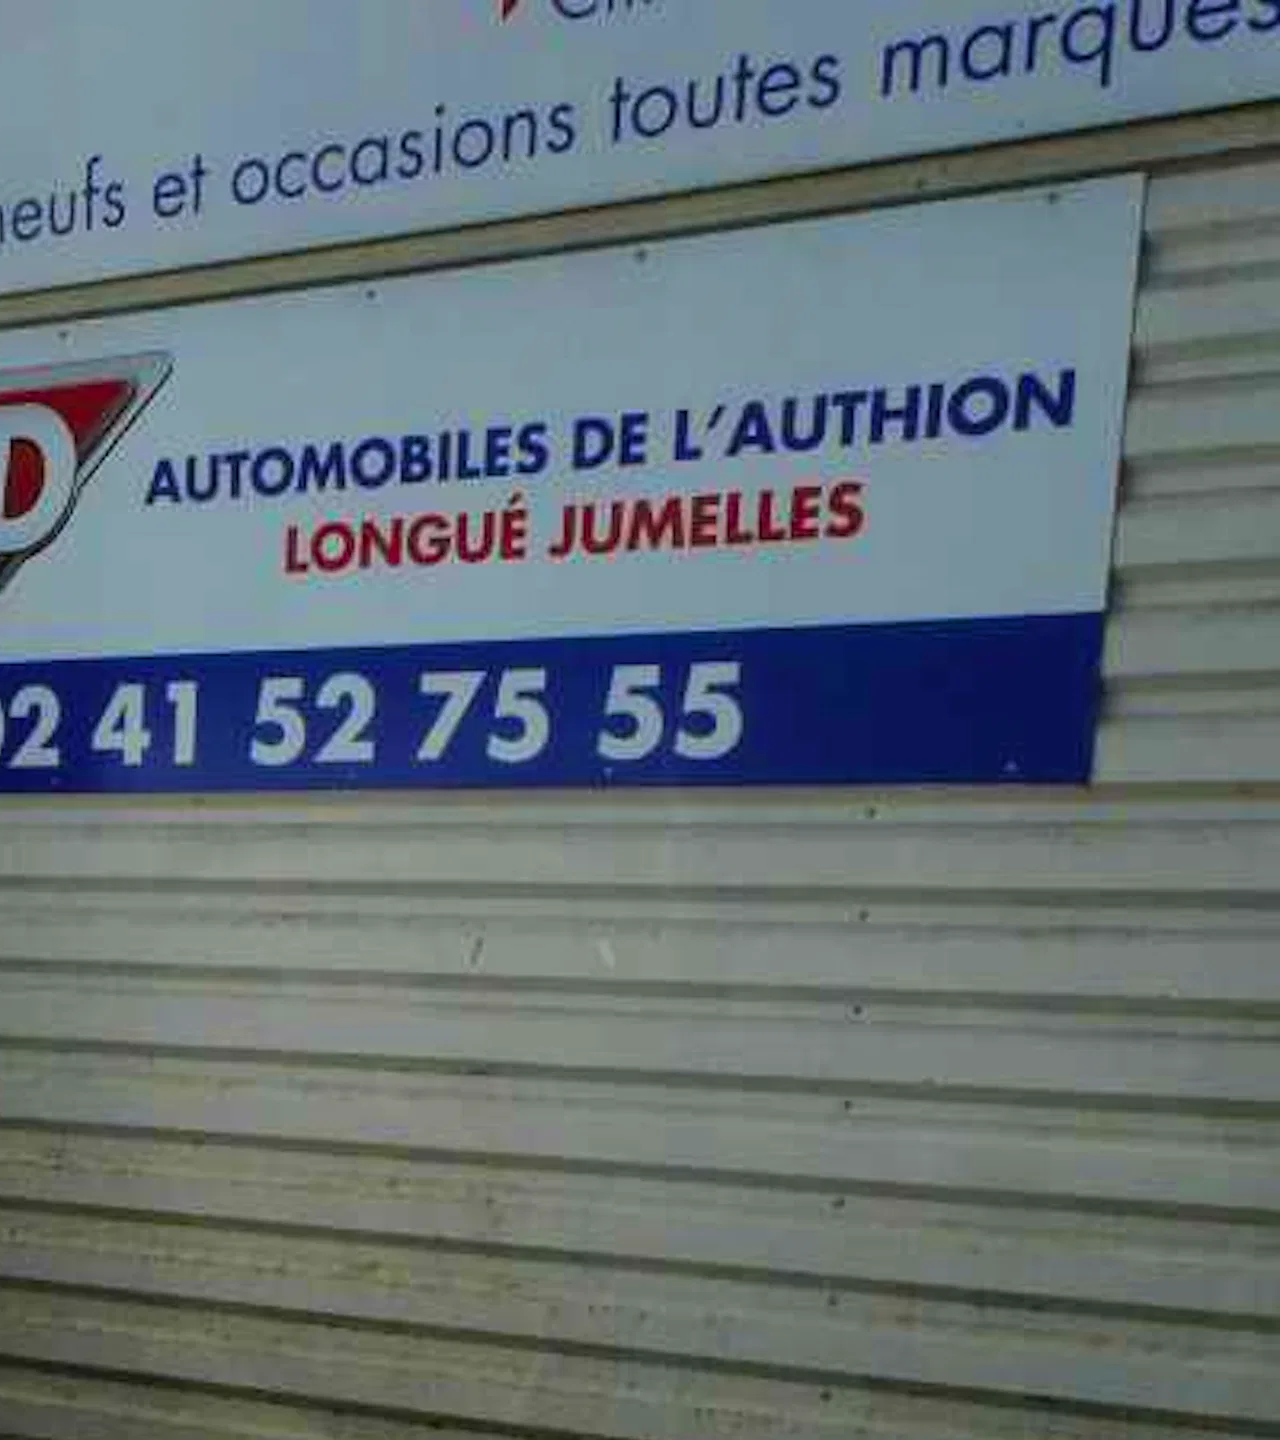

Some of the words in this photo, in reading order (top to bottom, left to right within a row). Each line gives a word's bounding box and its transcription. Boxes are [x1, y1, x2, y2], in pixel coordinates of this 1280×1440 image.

[153, 154, 206, 219] et
[230, 103, 575, 206] occasions
[610, 53, 841, 143] toutes
[144, 421, 549, 505] AUTOMOBILES
[571, 411, 649, 472] DE
[673, 367, 1077, 462] L'AUTHION
[284, 491, 527, 575] LONGUÉ
[547, 480, 868, 560] JUMELLES
[90, 679, 200, 767] 41
[249, 672, 377, 768] 52
[412, 666, 550, 765] 75
[596, 660, 743, 762] 55
